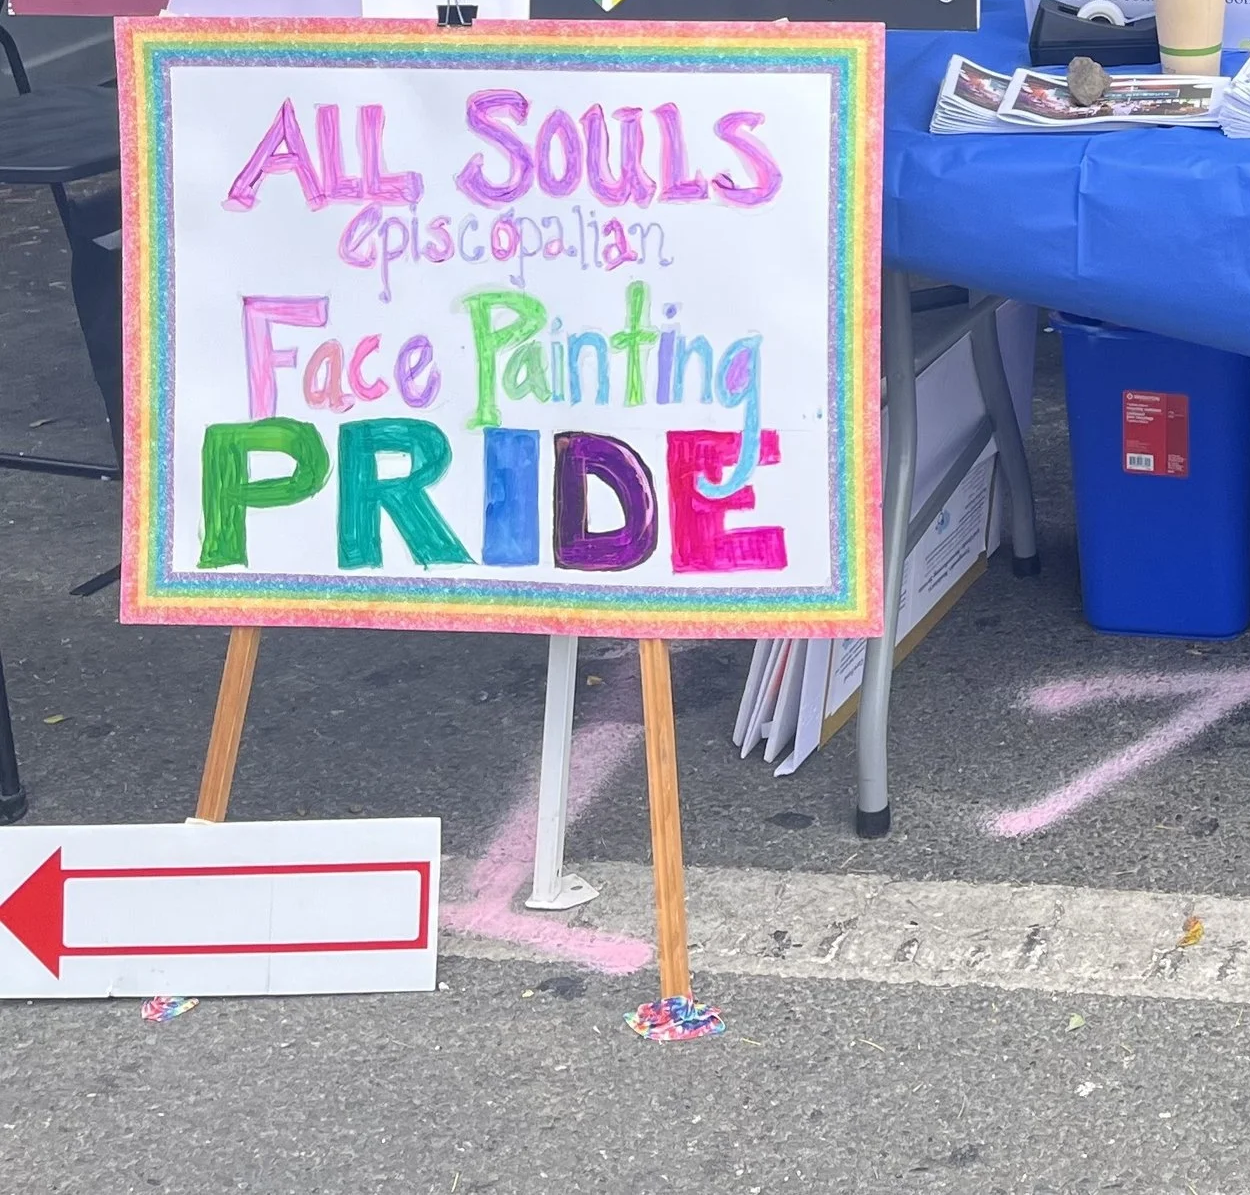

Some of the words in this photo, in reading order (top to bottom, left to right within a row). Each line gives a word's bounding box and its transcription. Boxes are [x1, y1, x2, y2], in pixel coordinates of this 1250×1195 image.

[221, 97, 424, 212] ALL
[455, 88, 784, 209] SOULS
[240, 294, 442, 420] Face
[458, 280, 764, 500] Painting
[198, 414, 789, 575] PRIDE
